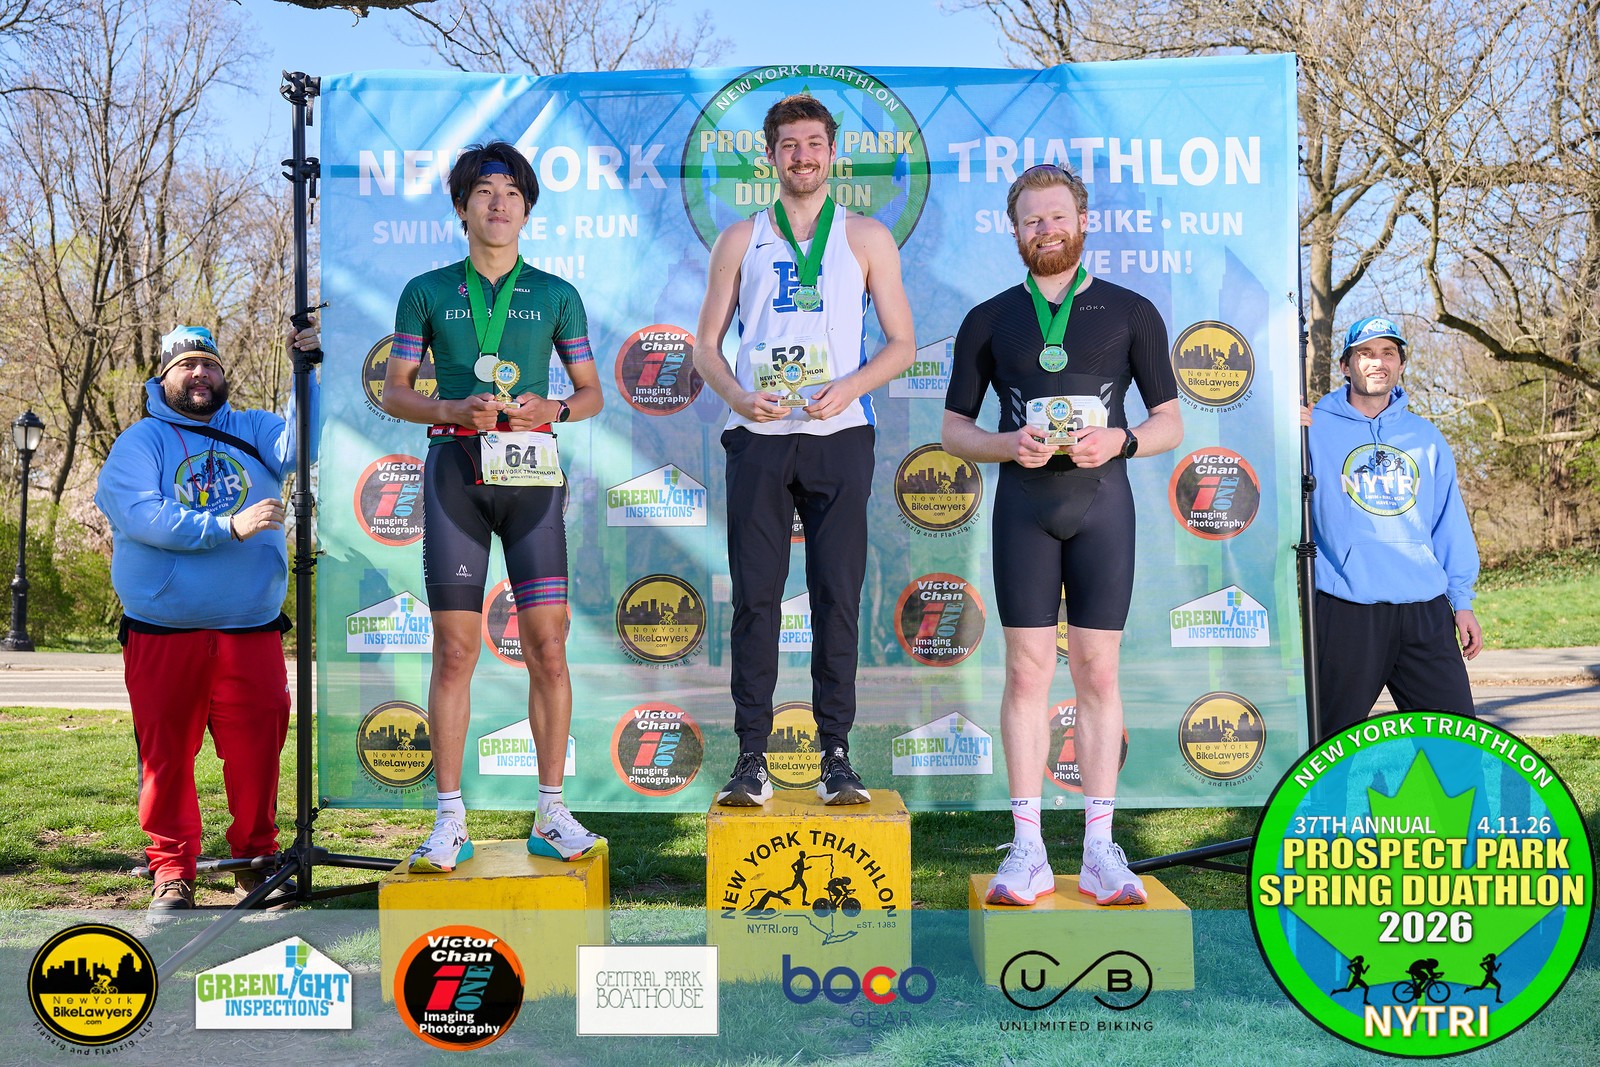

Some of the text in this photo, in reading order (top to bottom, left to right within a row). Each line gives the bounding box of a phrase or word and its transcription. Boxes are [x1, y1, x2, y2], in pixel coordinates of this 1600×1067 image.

[715, 64, 900, 112] NEW YORK TRIATHLON
[844, 131, 914, 154] PARK
[1180, 211, 1243, 236] RUN
[372, 214, 638, 244] SWIM RUN
[1121, 250, 1192, 274] FUN!
[639, 332, 689, 341] Victor
[641, 342, 684, 351] Chan
[772, 346, 806, 371] 52
[1188, 378, 1239, 388] BikeLawyers
[635, 386, 671, 396] Imaging
[632, 395, 689, 404] Photography
[505, 444, 538, 468] 64
[1192, 455, 1242, 464] Victor
[376, 462, 423, 471] Victor
[1195, 465, 1238, 475] Chan
[379, 472, 420, 481] Chan
[1341, 472, 1420, 496] NYTRI
[912, 503, 966, 512] BikeLawyers
[1190, 510, 1227, 520] Imaging
[373, 518, 408, 526] Imaging
[1187, 519, 1245, 528] Photography
[370, 525, 424, 535] Photography
[917, 581, 967, 590] Victor
[920, 591, 963, 600] Chan
[634, 634, 688, 643] BikeLawyers
[915, 637, 951, 647] Imaging
[912, 645, 969, 655] Photography
[634, 710, 684, 719] Victor
[637, 720, 681, 730] Chan
[1196, 752, 1249, 760] BikeLawyers
[373, 759, 425, 768] BikeLawyers
[632, 767, 668, 776] Imaging
[629, 775, 687, 785] Photography
[721, 830, 897, 919] NEW YORK TRIATHLON
[747, 924, 799, 935] NYTRI.org
